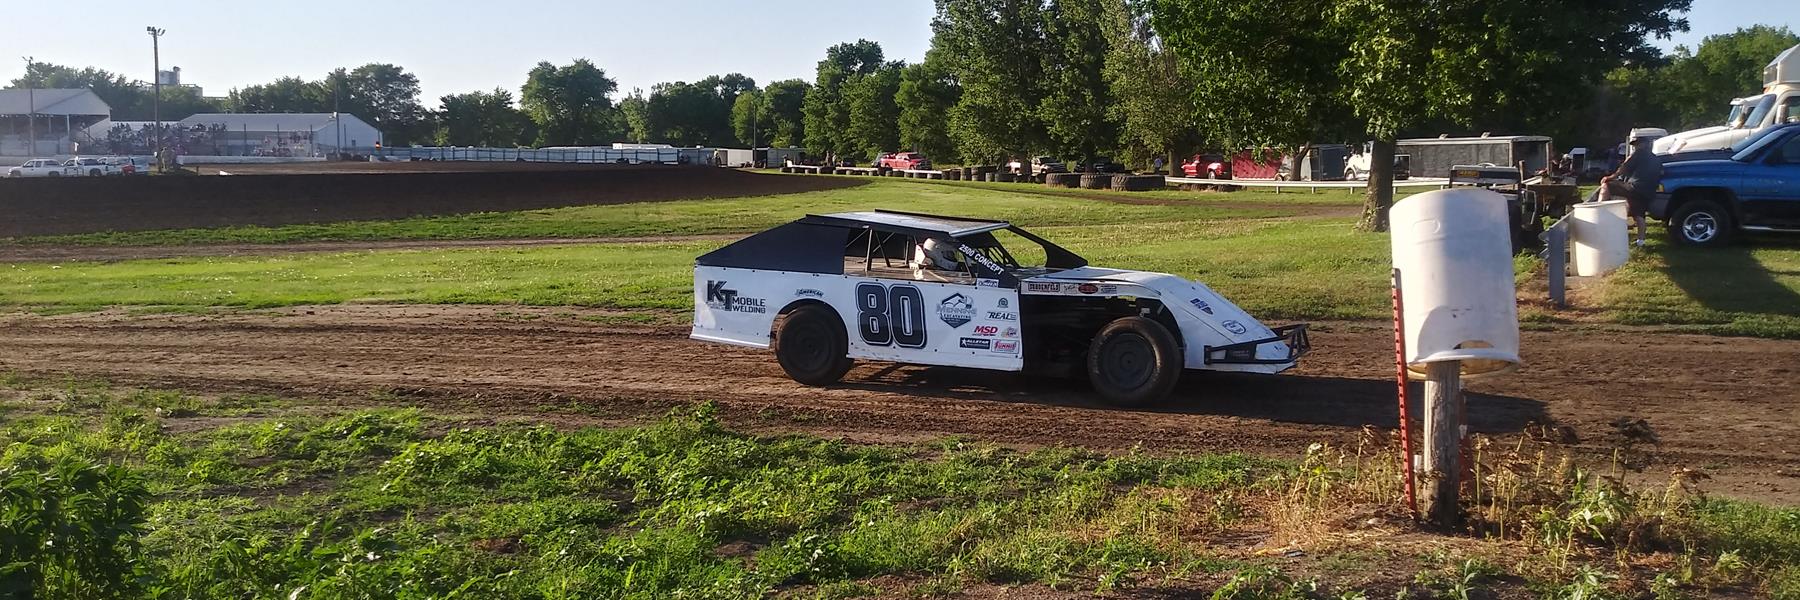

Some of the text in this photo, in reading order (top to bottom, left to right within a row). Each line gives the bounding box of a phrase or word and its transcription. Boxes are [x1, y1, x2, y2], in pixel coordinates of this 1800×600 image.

[959, 244, 1005, 275] 2500 CONCEPT
[732, 297, 766, 307] MOBILE
[732, 306, 766, 314] WELDING
[855, 281, 928, 349] 80
[974, 326, 998, 334] MSD
